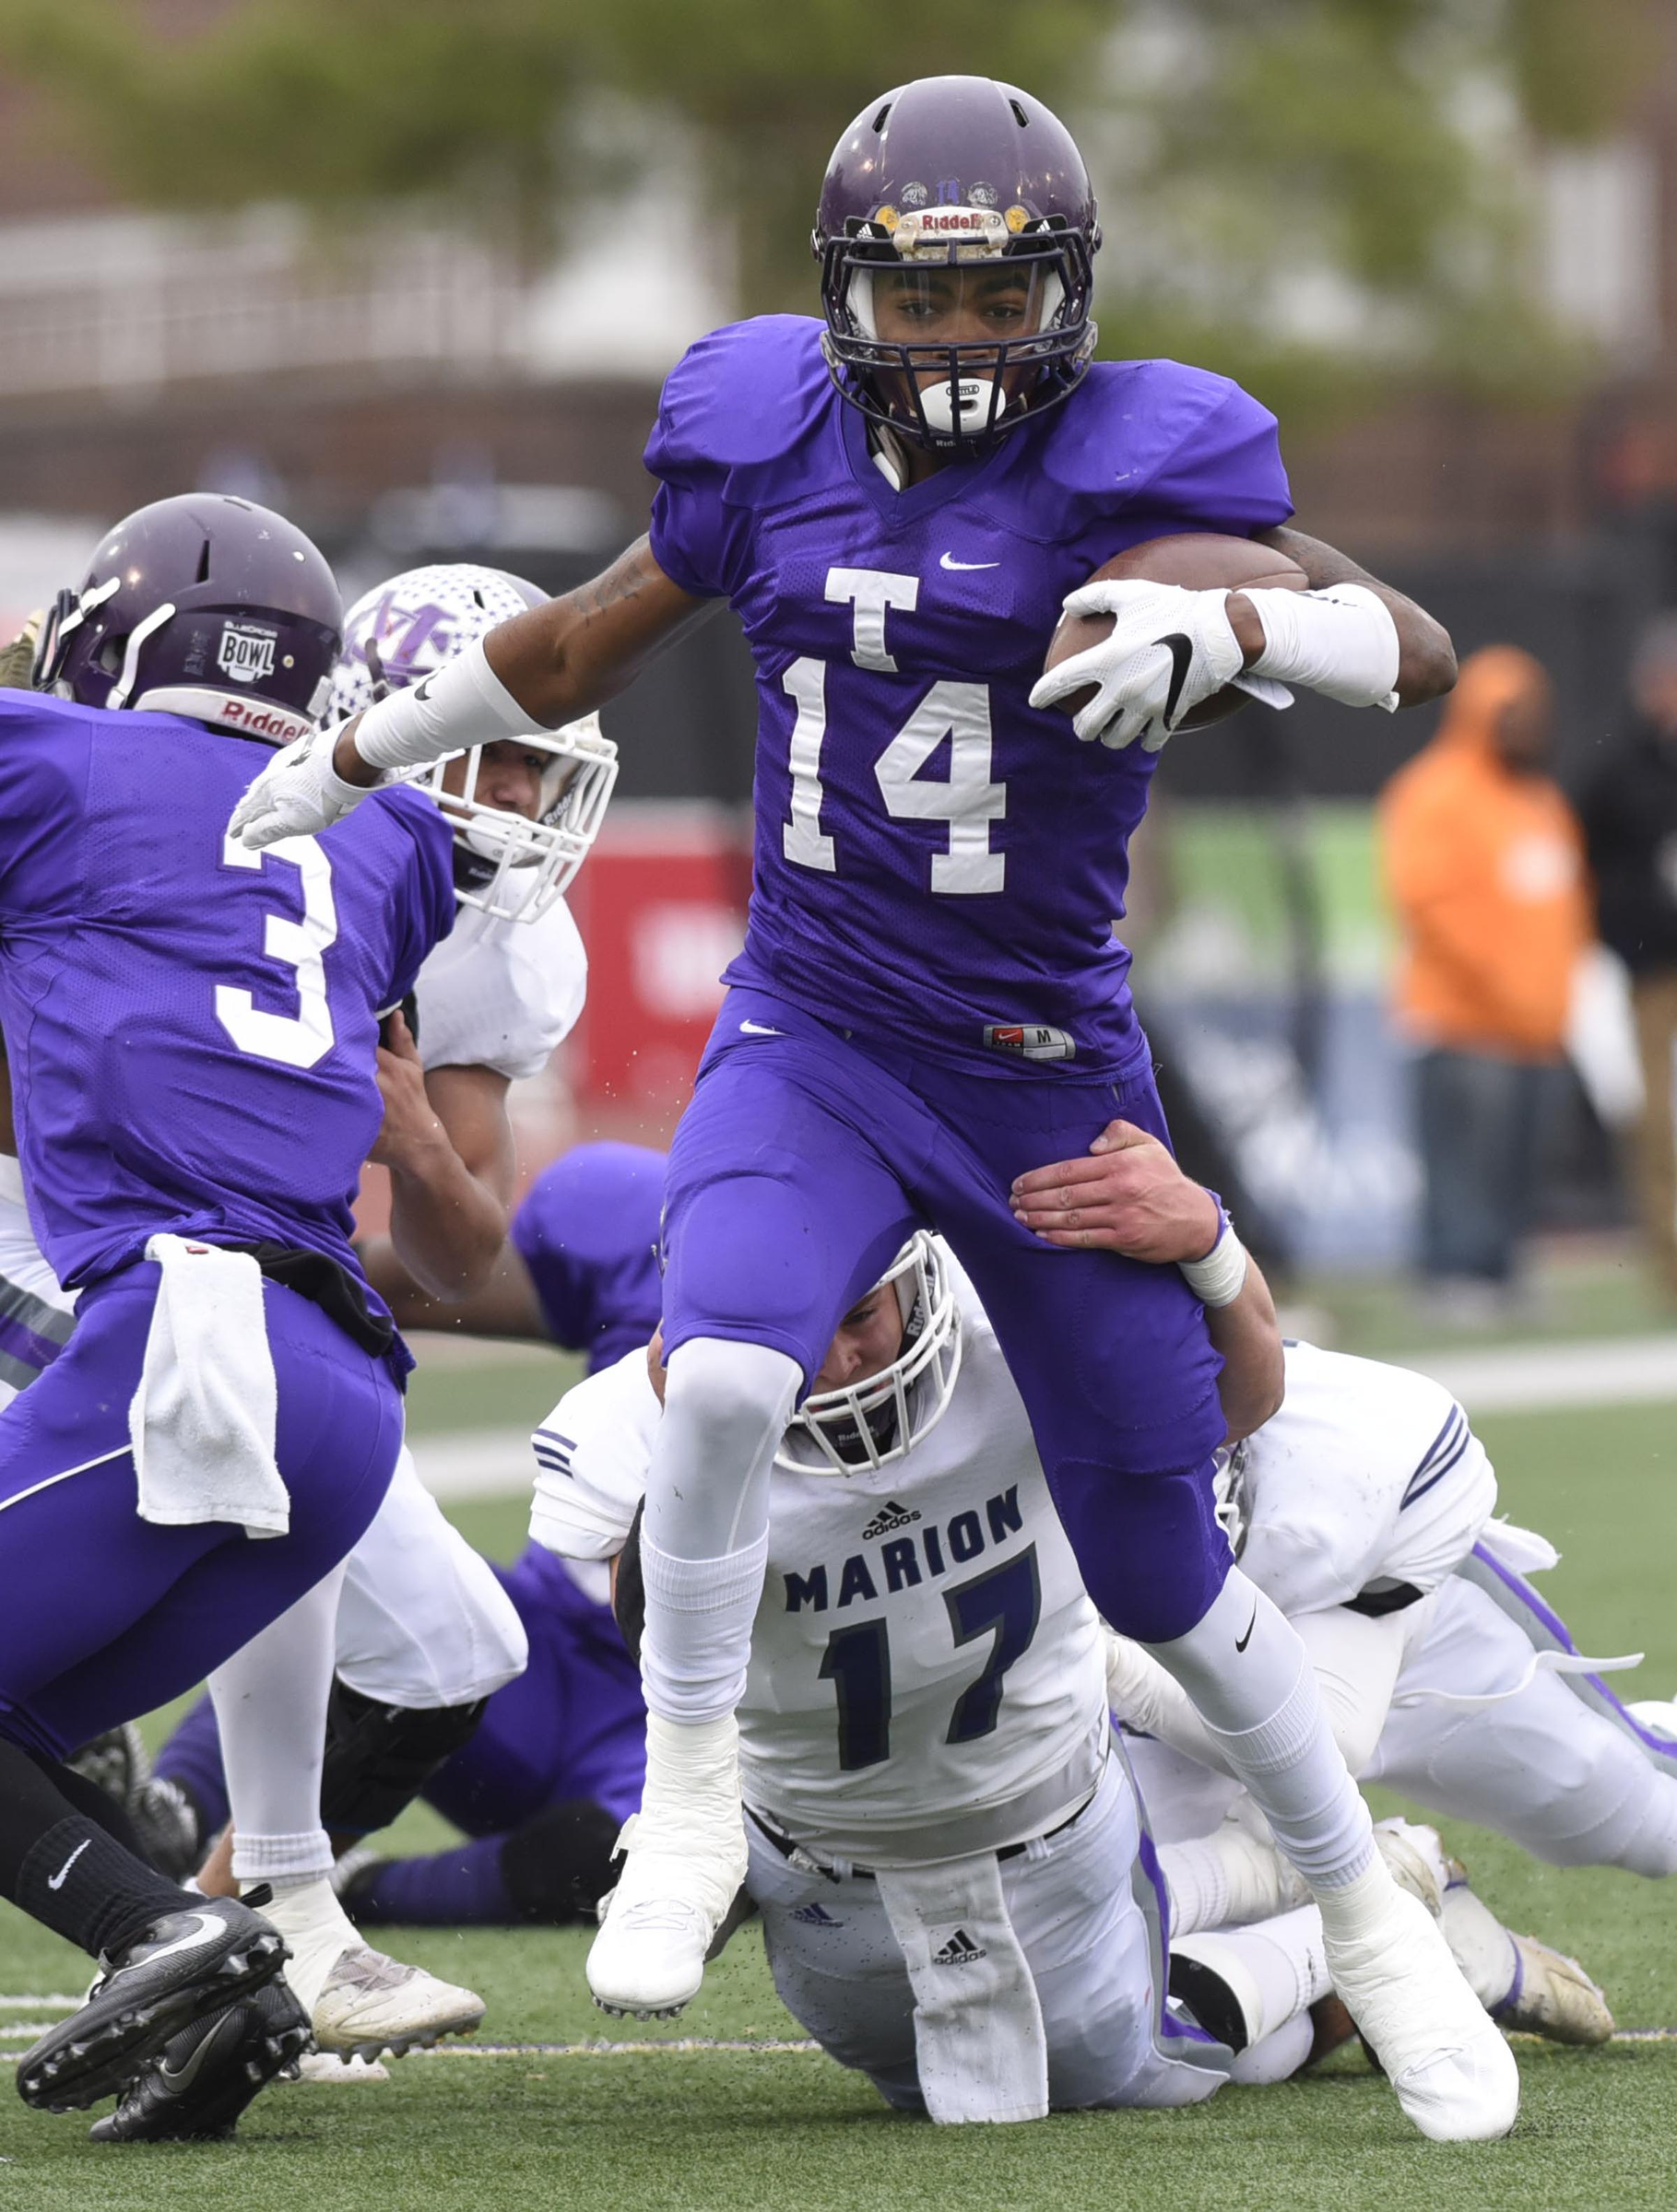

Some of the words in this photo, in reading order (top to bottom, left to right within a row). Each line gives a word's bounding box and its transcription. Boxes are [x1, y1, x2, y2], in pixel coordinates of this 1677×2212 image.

[222, 635, 272, 671] BOWL
[824, 567, 919, 672] T
[782, 656, 1007, 894] 14
[215, 832, 338, 1069] 3
[1036, 1030, 1052, 1043] M
[784, 1483, 1023, 1613] MARION
[863, 1509, 922, 1541] adidas
[817, 1540, 1043, 1771] 17
[934, 1948, 987, 1966] adidas
